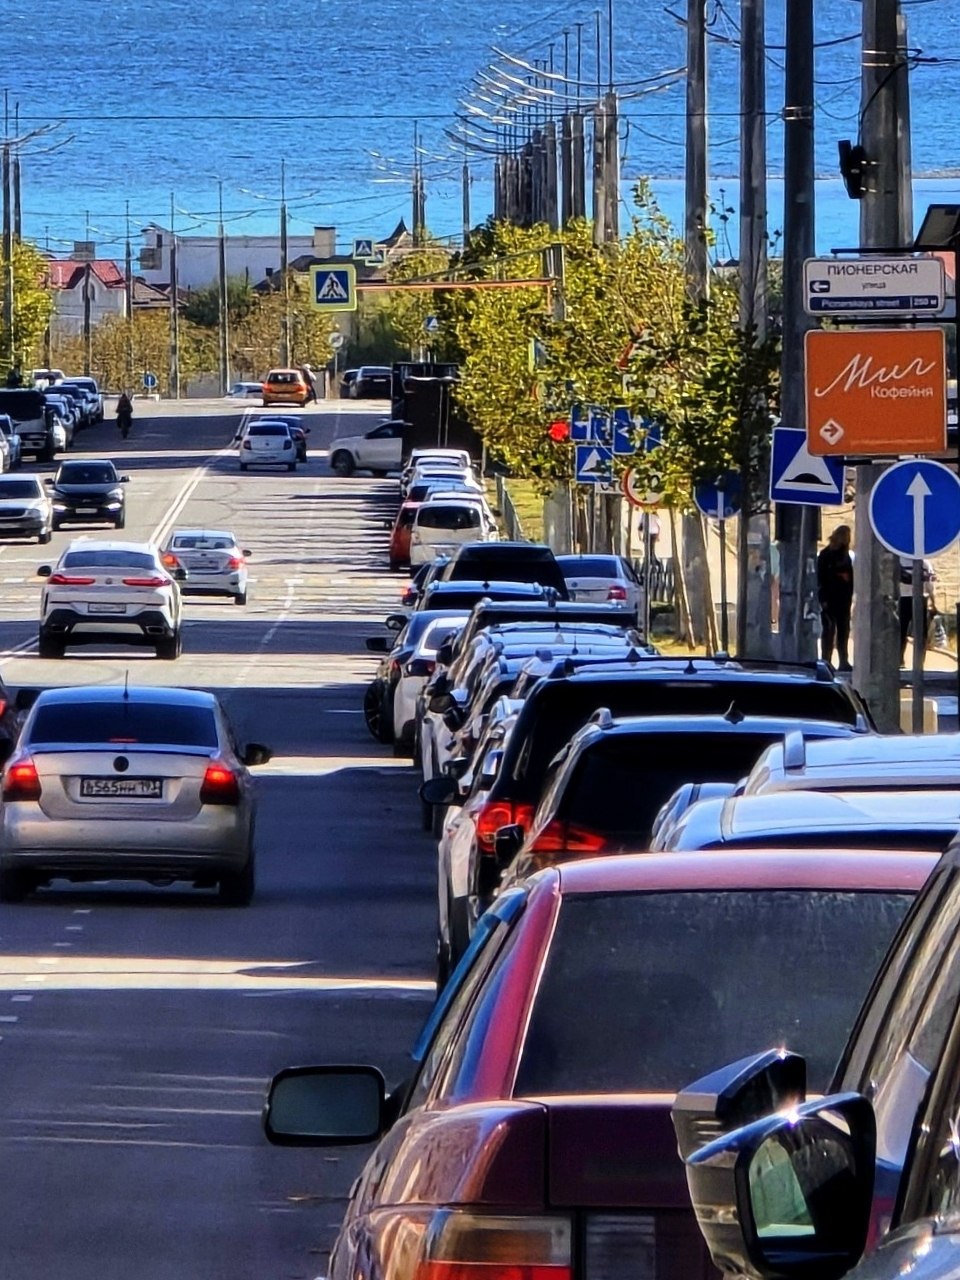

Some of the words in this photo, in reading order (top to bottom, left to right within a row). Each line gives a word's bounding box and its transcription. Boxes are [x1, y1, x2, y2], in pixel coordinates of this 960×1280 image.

[827, 263, 918, 276] ПИОНЕРСКАЯ
[862, 281, 887, 291] улица
[870, 384, 934, 400] Кофейня
